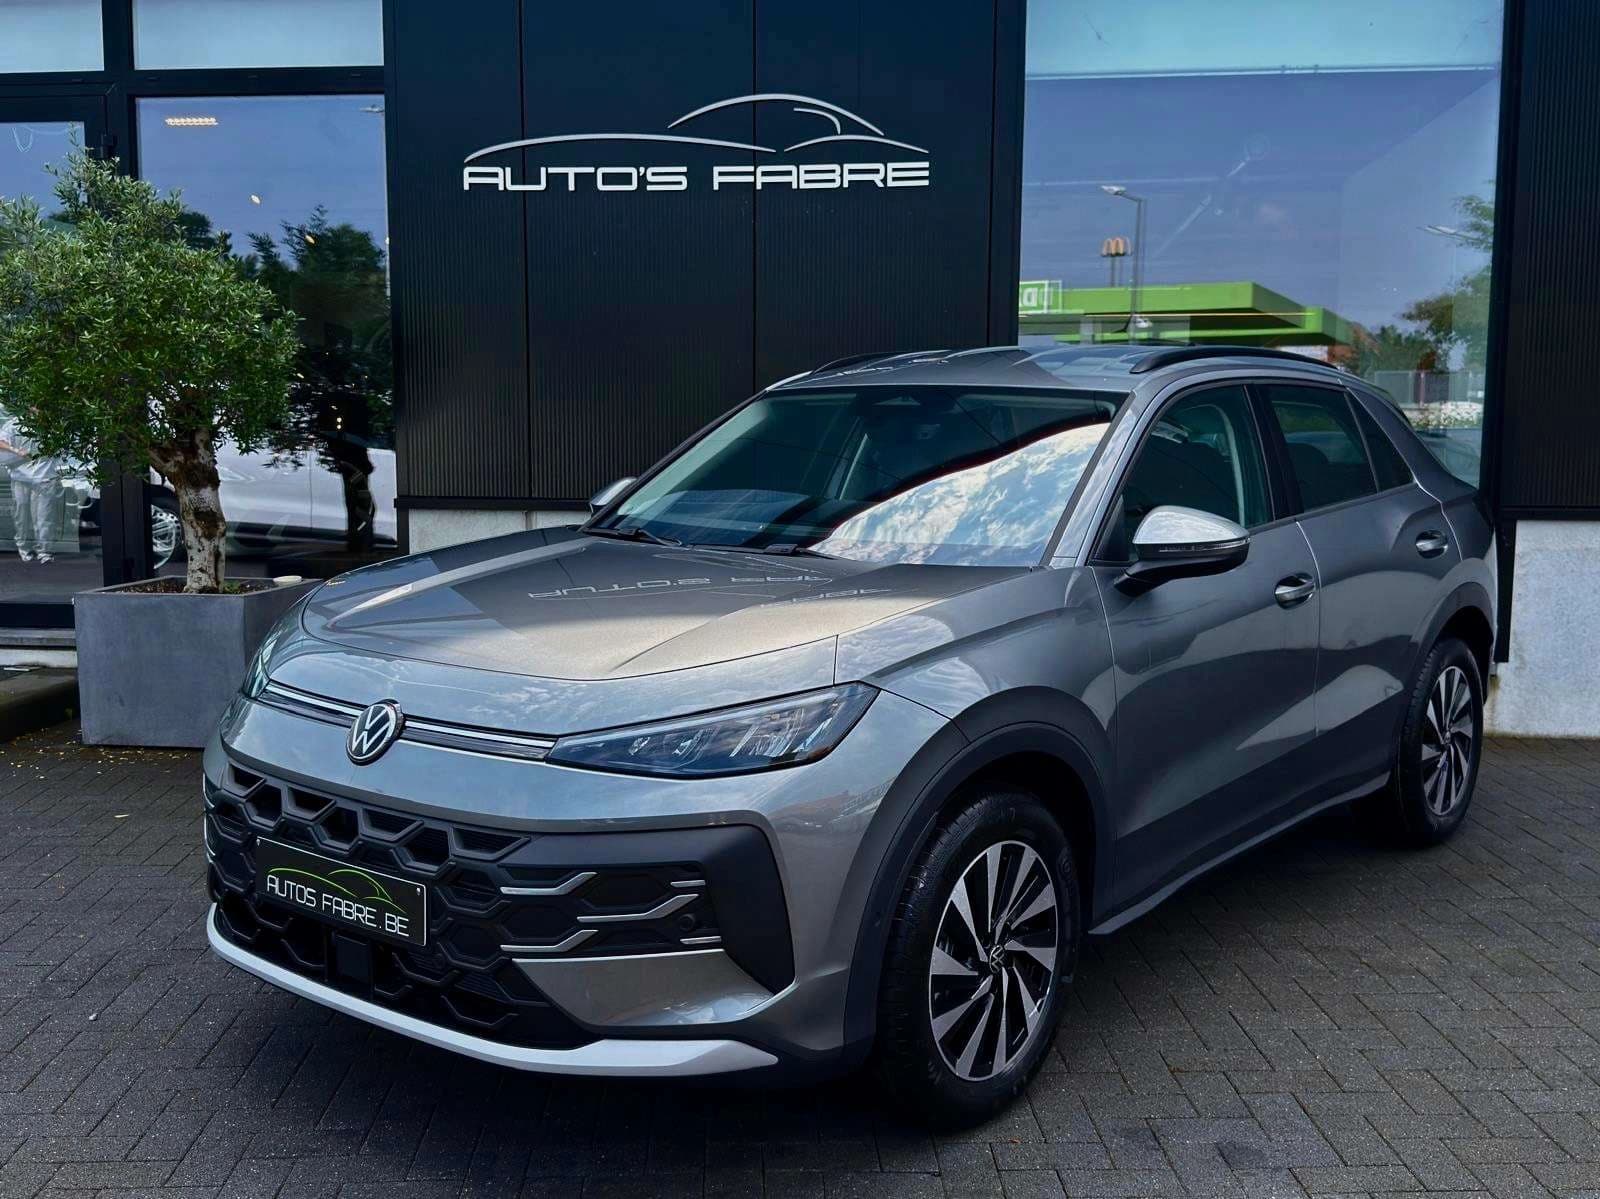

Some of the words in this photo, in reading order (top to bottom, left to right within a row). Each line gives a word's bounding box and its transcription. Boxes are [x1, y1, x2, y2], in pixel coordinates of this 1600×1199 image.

[463, 166, 687, 191] AUTO'S
[713, 161, 929, 190] FABRE
[266, 875, 317, 908] AUTOS
